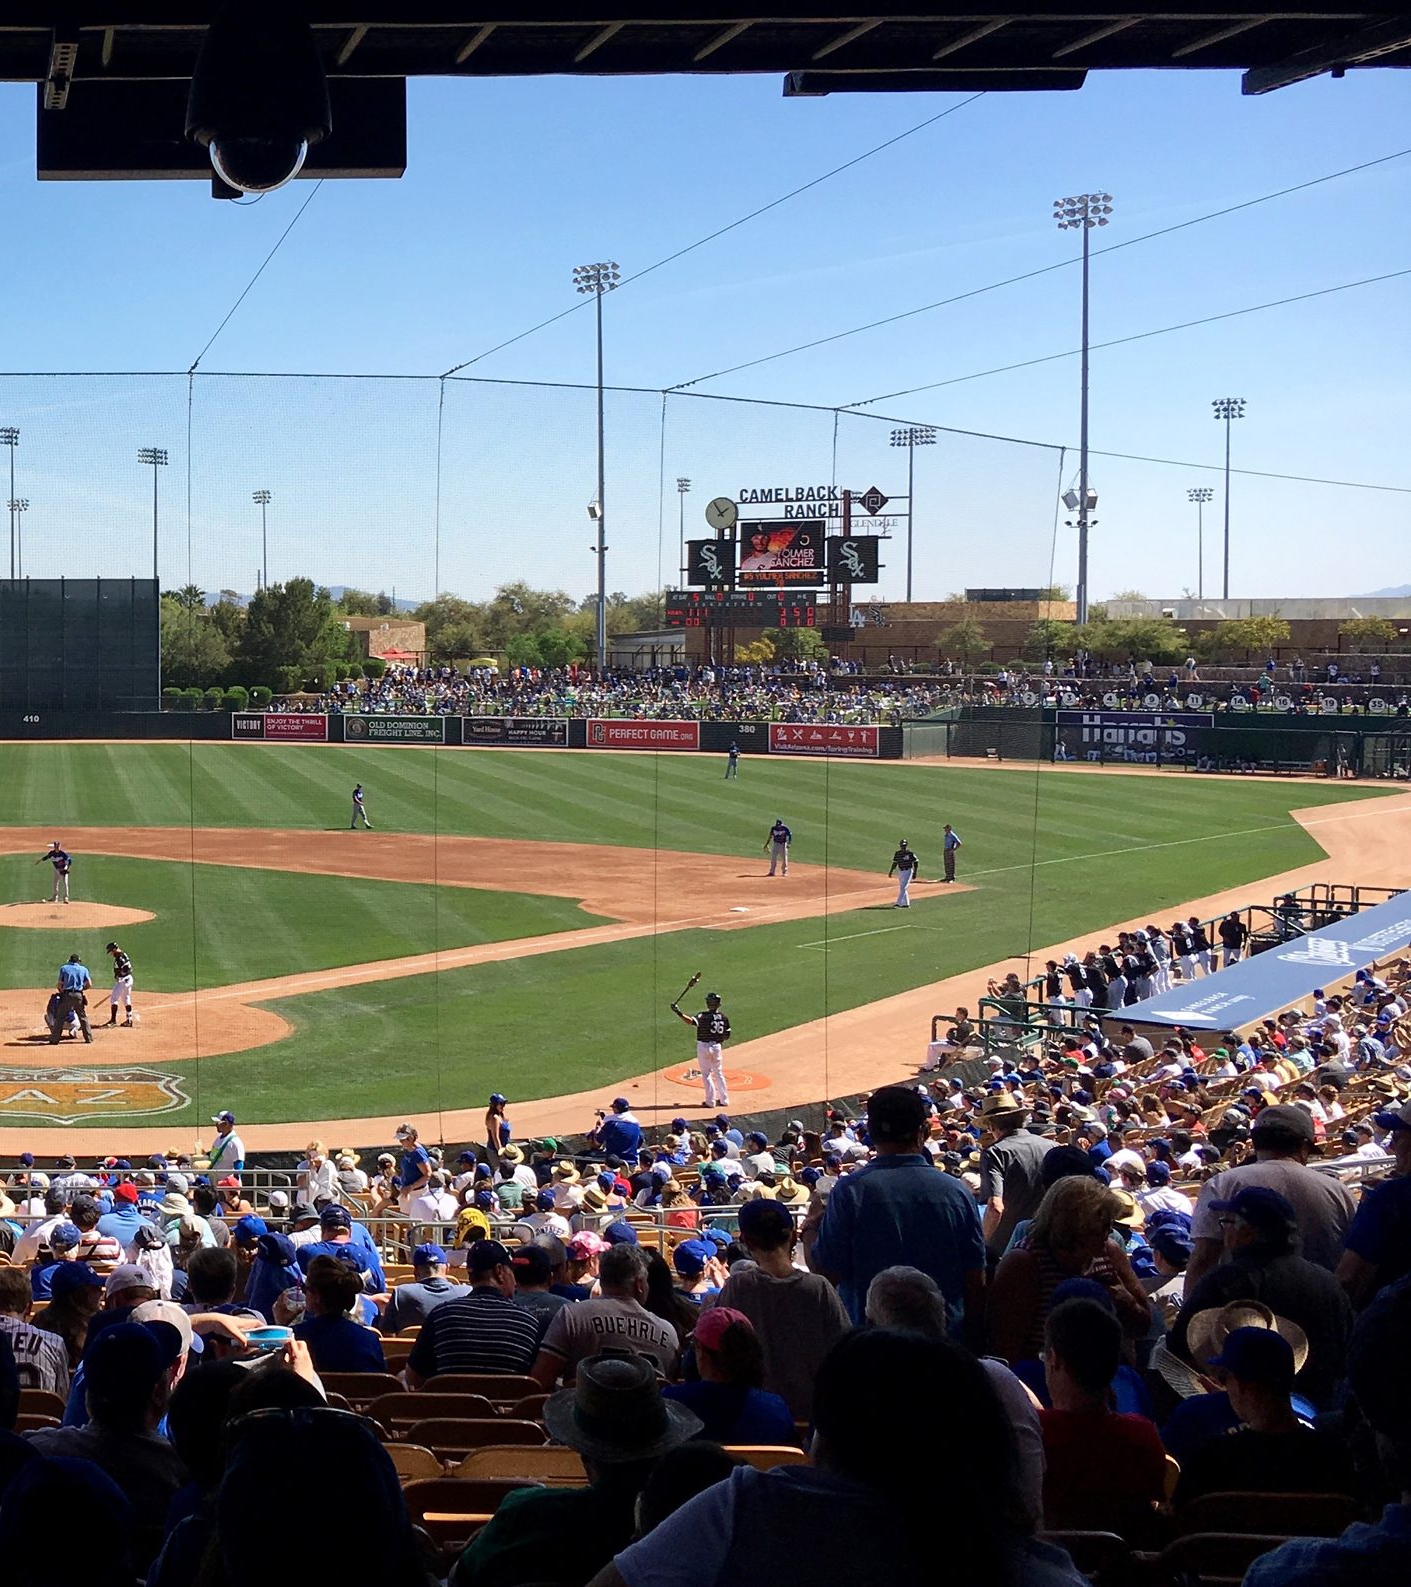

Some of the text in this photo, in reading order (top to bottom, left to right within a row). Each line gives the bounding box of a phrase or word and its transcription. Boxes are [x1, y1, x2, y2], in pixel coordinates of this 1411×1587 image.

[740, 486, 838, 502] CAMELBACK
[785, 503, 839, 518] RANCH
[777, 549, 814, 558] YOLMER
[770, 558, 815, 567] SANCHEZ
[22, 715, 40, 723] 410
[236, 719, 261, 730] VICTORY
[369, 721, 429, 730] OLD DOMINION
[739, 725, 756, 734] 380
[369, 729, 403, 737] FREIGHT
[609, 728, 649, 739] PERFECT
[0, 1088, 128, 1104] AZ
[592, 1316, 669, 1348] BUEHRLE
